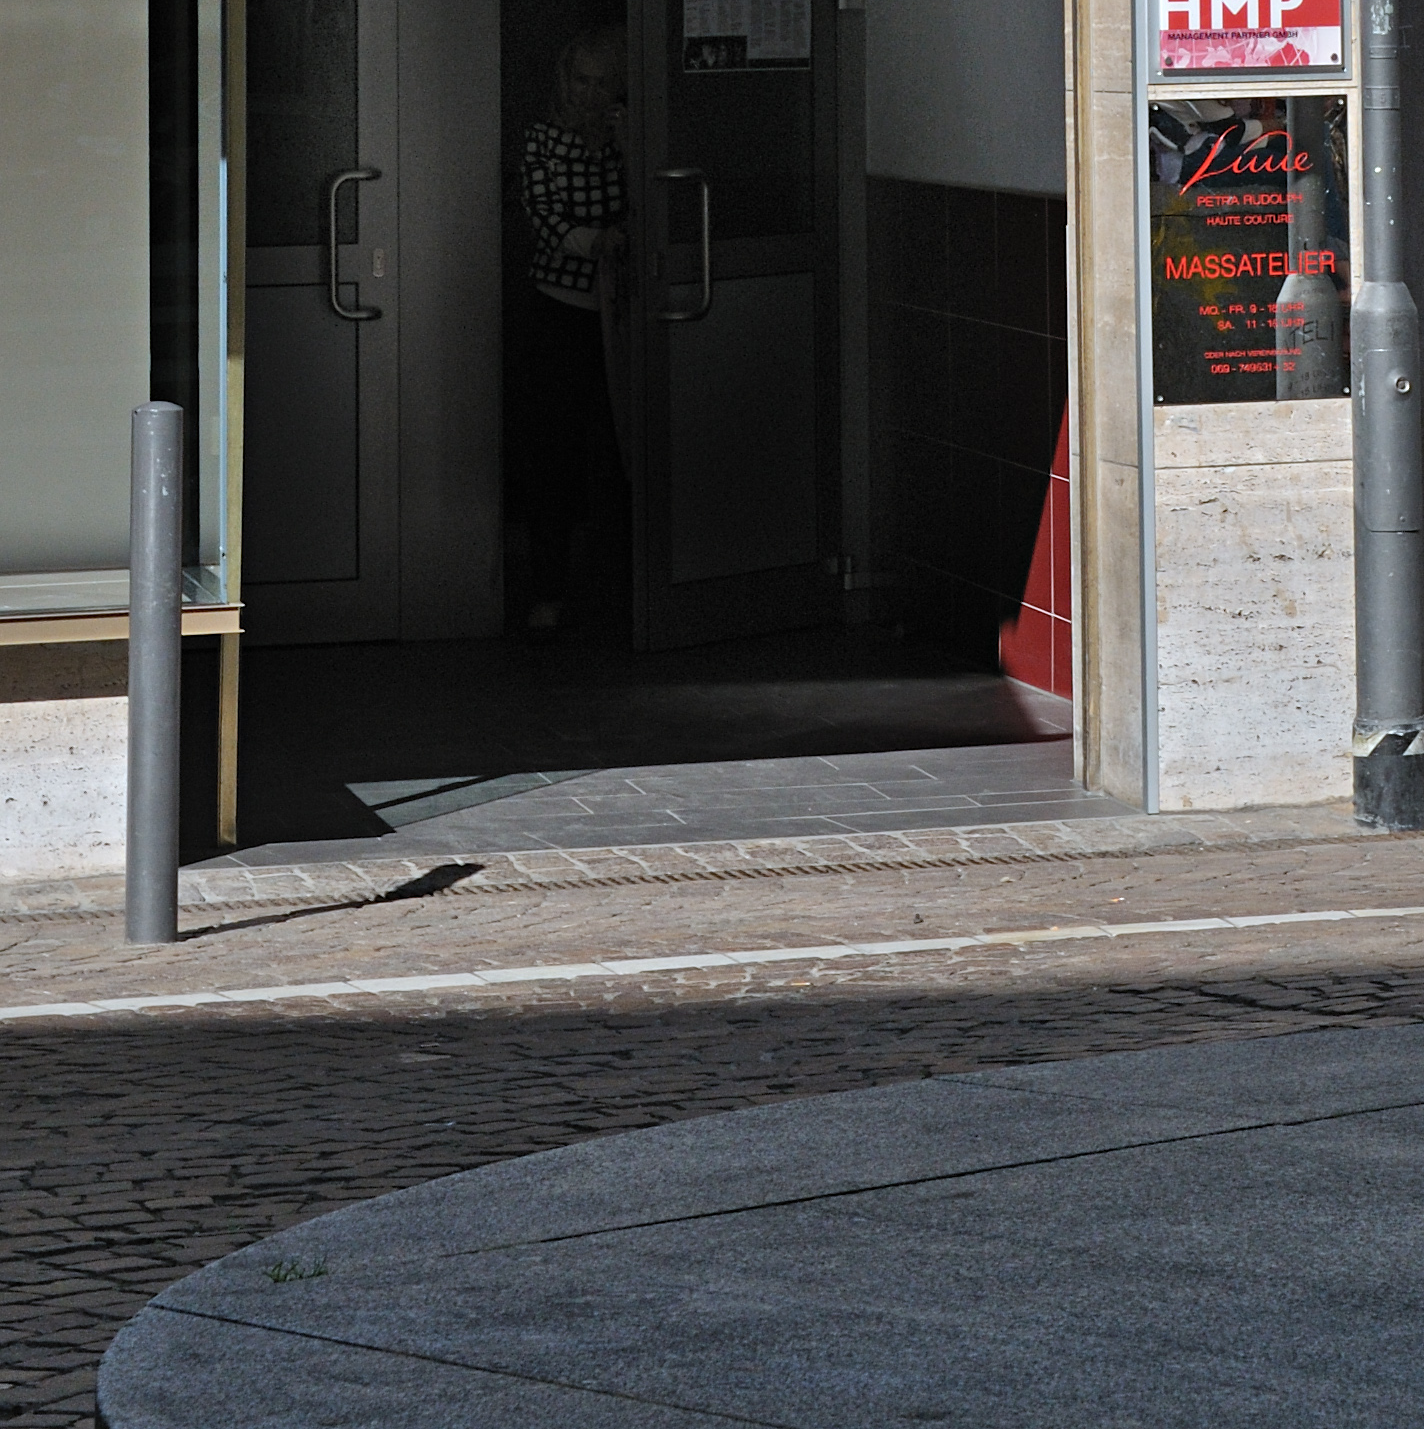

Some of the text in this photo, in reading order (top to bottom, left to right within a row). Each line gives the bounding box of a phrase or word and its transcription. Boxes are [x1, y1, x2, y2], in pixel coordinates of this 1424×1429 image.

[1167, 32, 1229, 42] MANAGEMENT
[1231, 31, 1271, 41] PARTNER
[1197, 193, 1304, 207] PETRA RUDOLPH
[1206, 213, 1295, 226] HAUTE COUTURE
[1166, 251, 1336, 280] MASSATELIER
